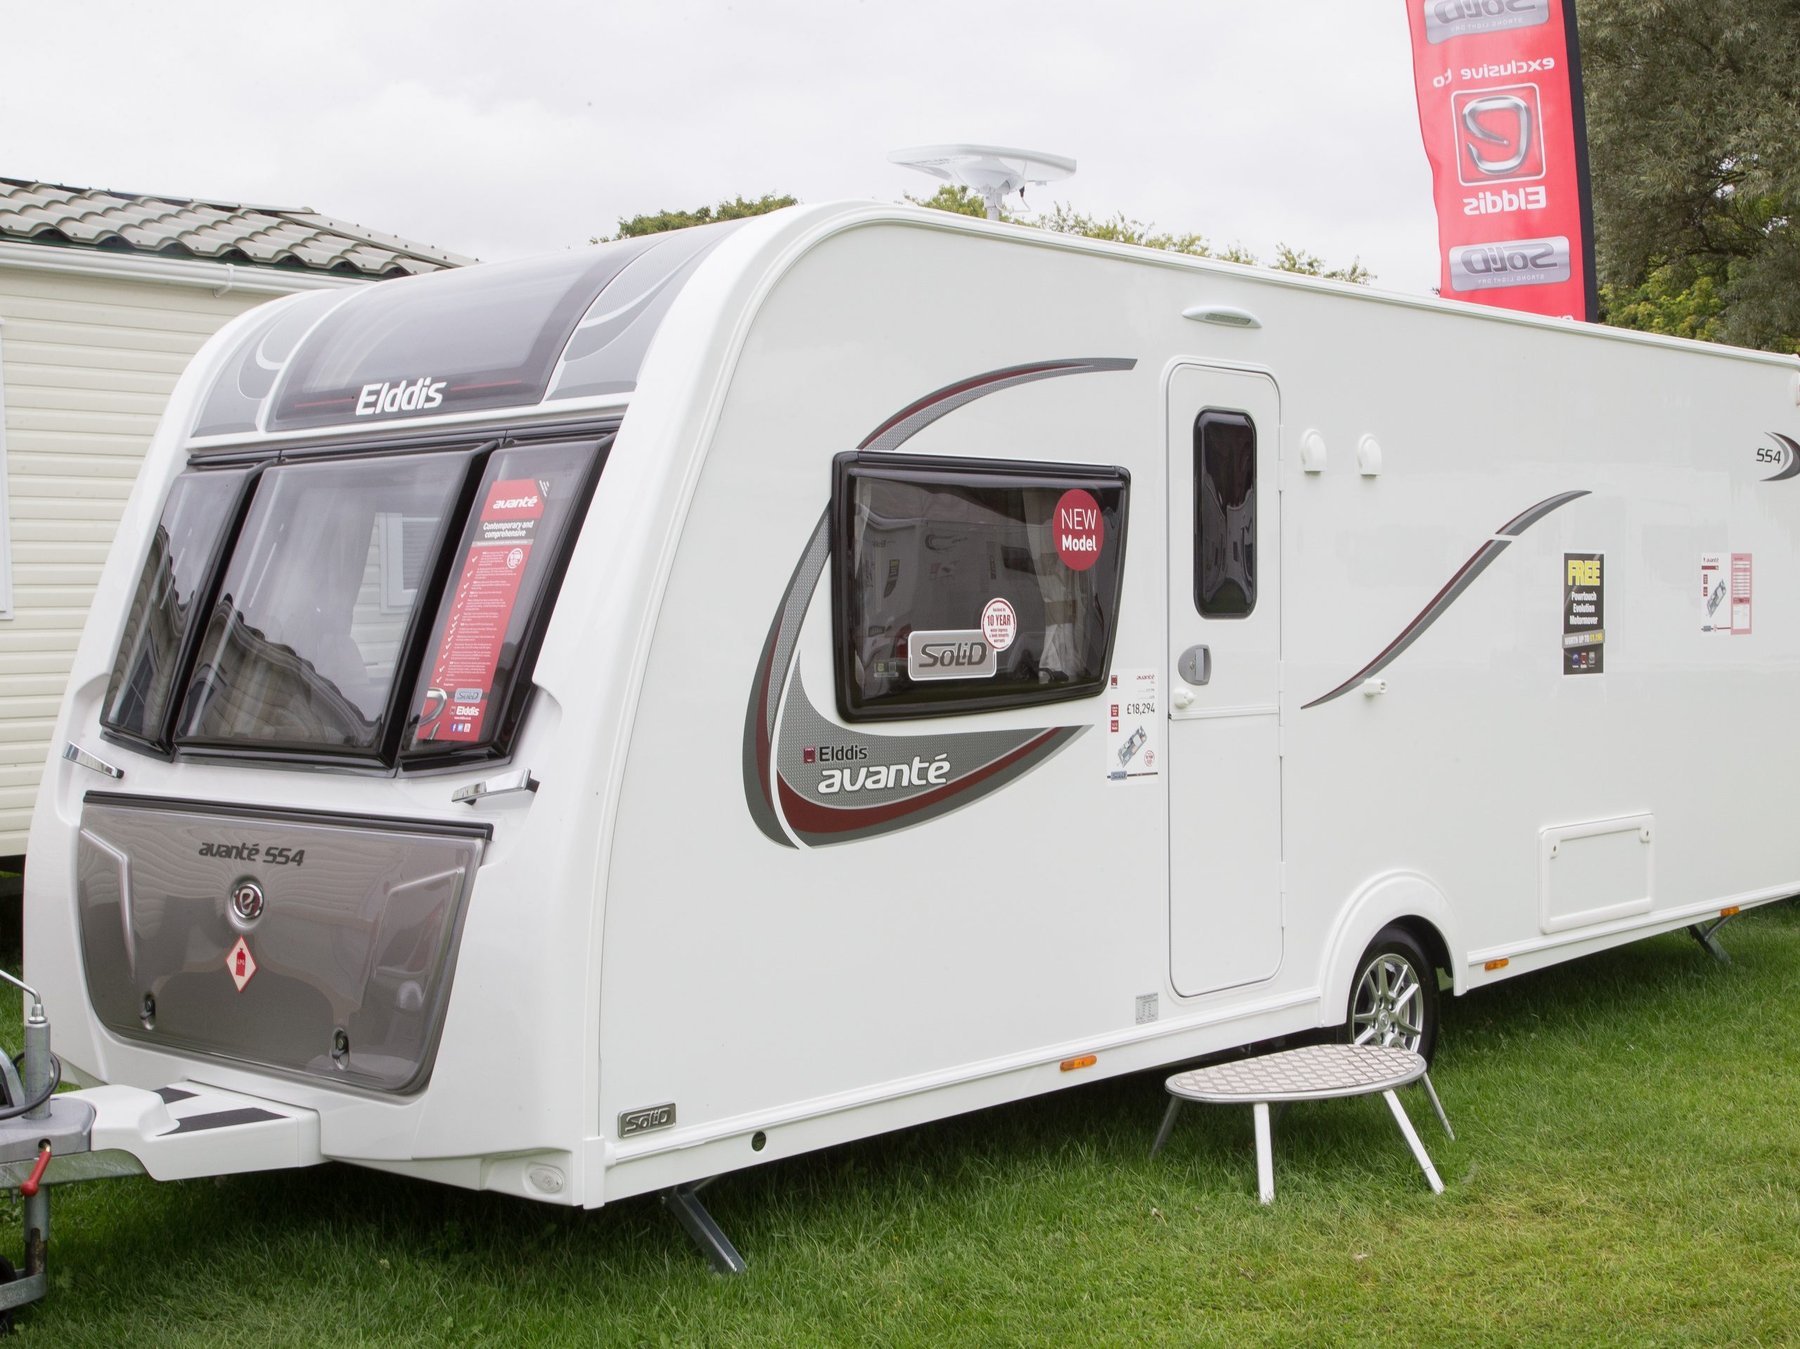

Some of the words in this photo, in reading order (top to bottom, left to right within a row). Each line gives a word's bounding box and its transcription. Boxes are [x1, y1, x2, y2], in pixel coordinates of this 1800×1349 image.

[355, 376, 448, 416] Elddis
[1756, 448, 1781, 464] 554
[493, 495, 538, 510] avanté
[1061, 507, 1097, 530] NEW
[1062, 534, 1097, 552] Model
[1567, 560, 1601, 586] FREE
[987, 614, 995, 626] 10
[995, 614, 1011, 626] YEAR
[456, 706, 480, 716] Elddis
[1127, 702, 1156, 715] £18,294
[819, 745, 868, 762] Elddis
[817, 753, 951, 794] avanté
[199, 842, 260, 862] avanté
[262, 846, 306, 866] 554
